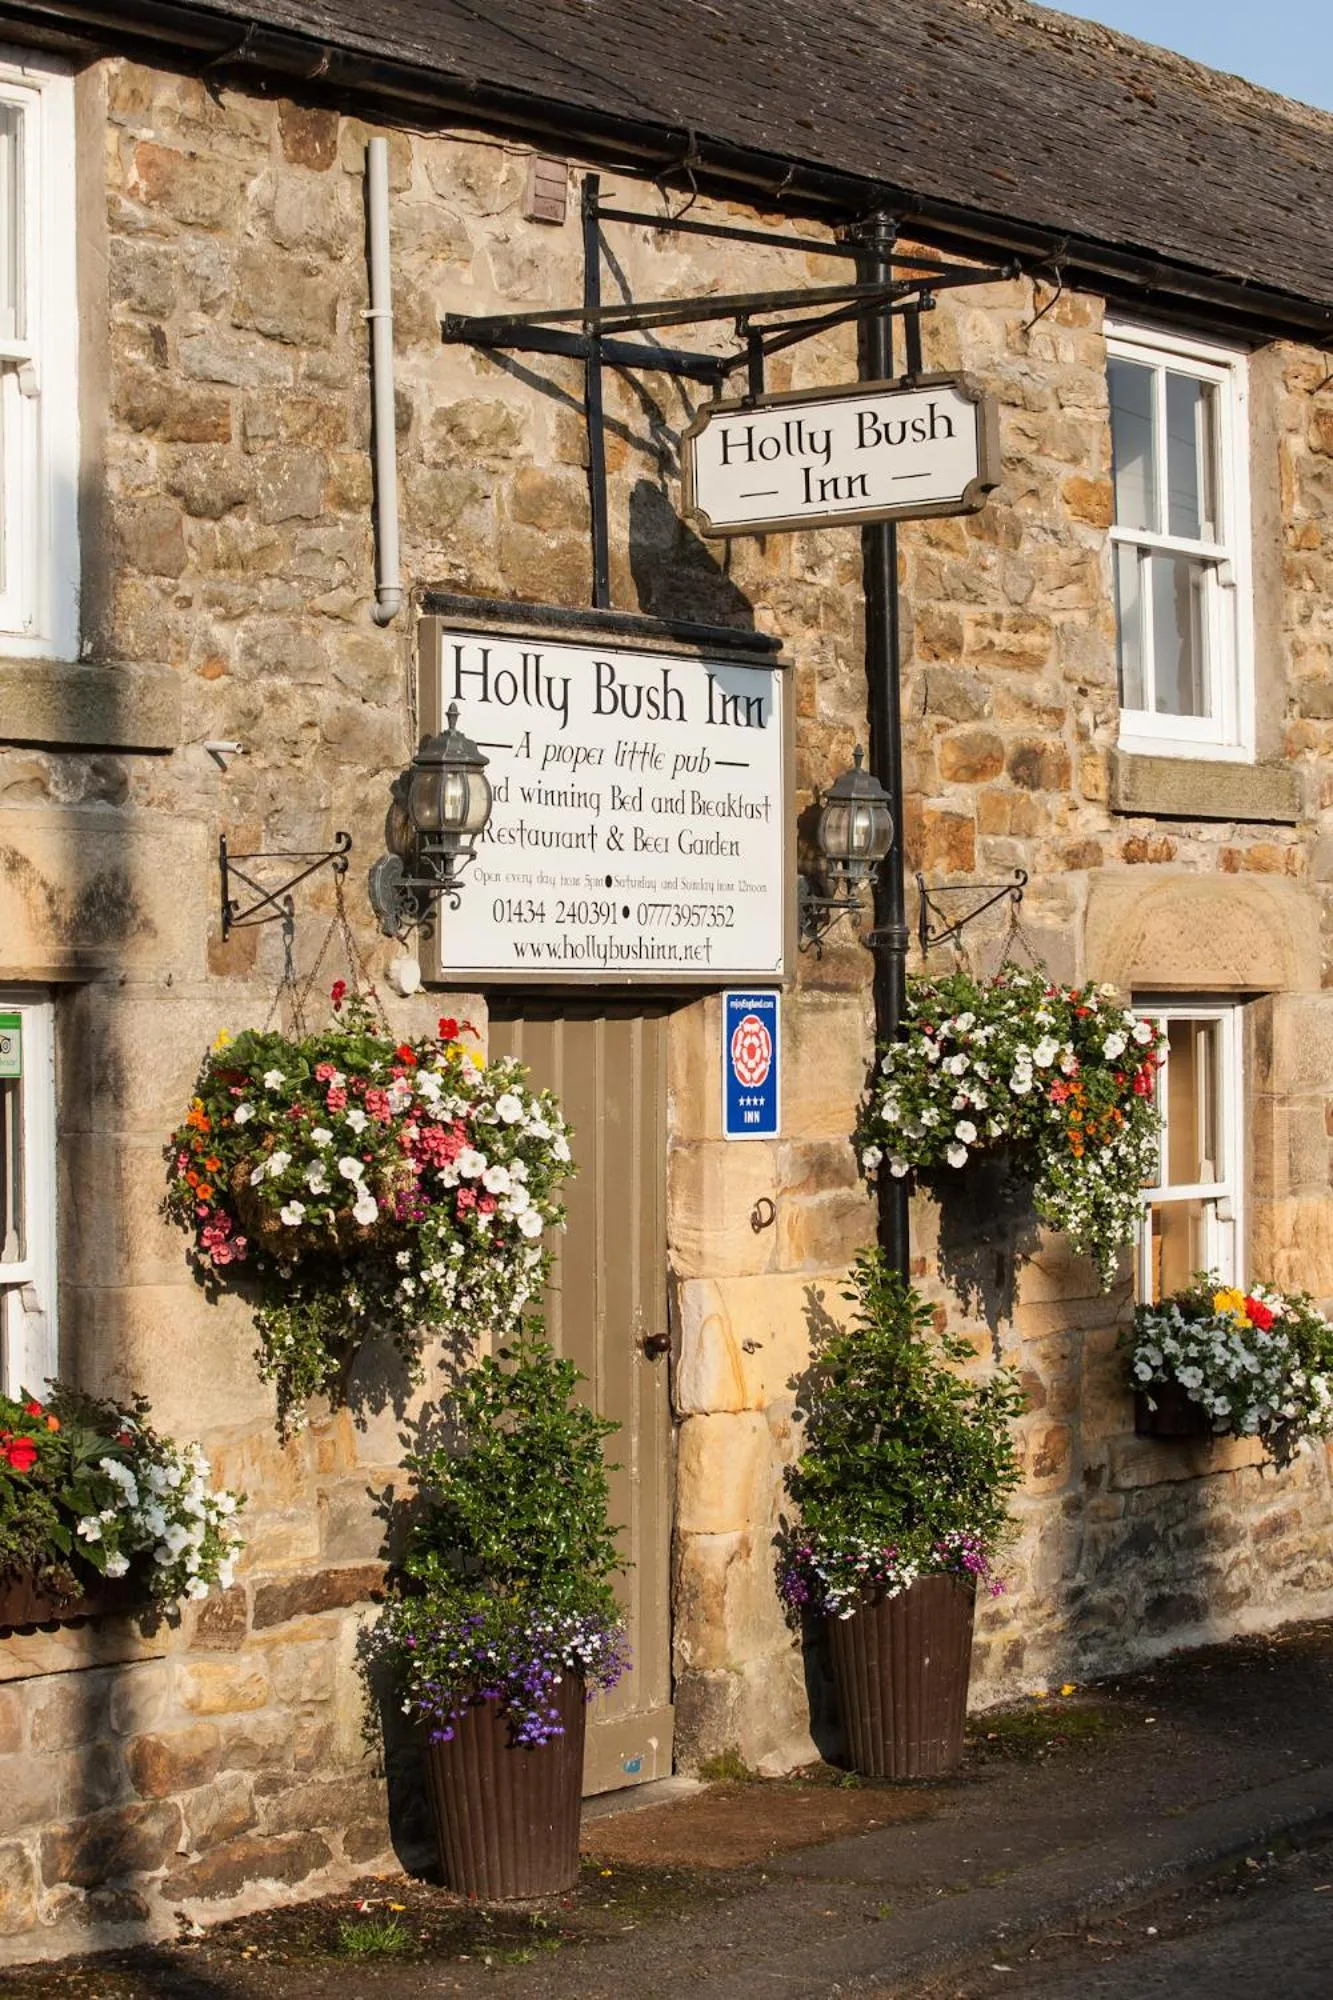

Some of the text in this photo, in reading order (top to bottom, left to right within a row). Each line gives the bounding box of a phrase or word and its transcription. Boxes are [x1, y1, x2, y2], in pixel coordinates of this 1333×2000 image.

[719, 402, 956, 466] Holly Bush
[800, 466, 872, 504] Inn
[452, 645, 767, 730] Holly Bush Inn
[514, 732, 710, 780] A proper little pub
[520, 779, 600, 818] winning
[611, 785, 642, 812] Bed
[652, 789, 685, 814] and
[690, 790, 772, 822] Breakfast
[481, 818, 740, 856] Restaurant & Beer Garden
[474, 868, 501, 886] Open
[505, 872, 532, 885] every
[536, 869, 556, 888] day
[614, 875, 656, 892] Saturday
[660, 877, 678, 890] and
[681, 878, 714, 894] Sunday
[493, 898, 735, 928] 01434 240391 07773957352
[513, 934, 713, 967] www.hollybushinn.net
[744, 1110, 760, 1124] INN
